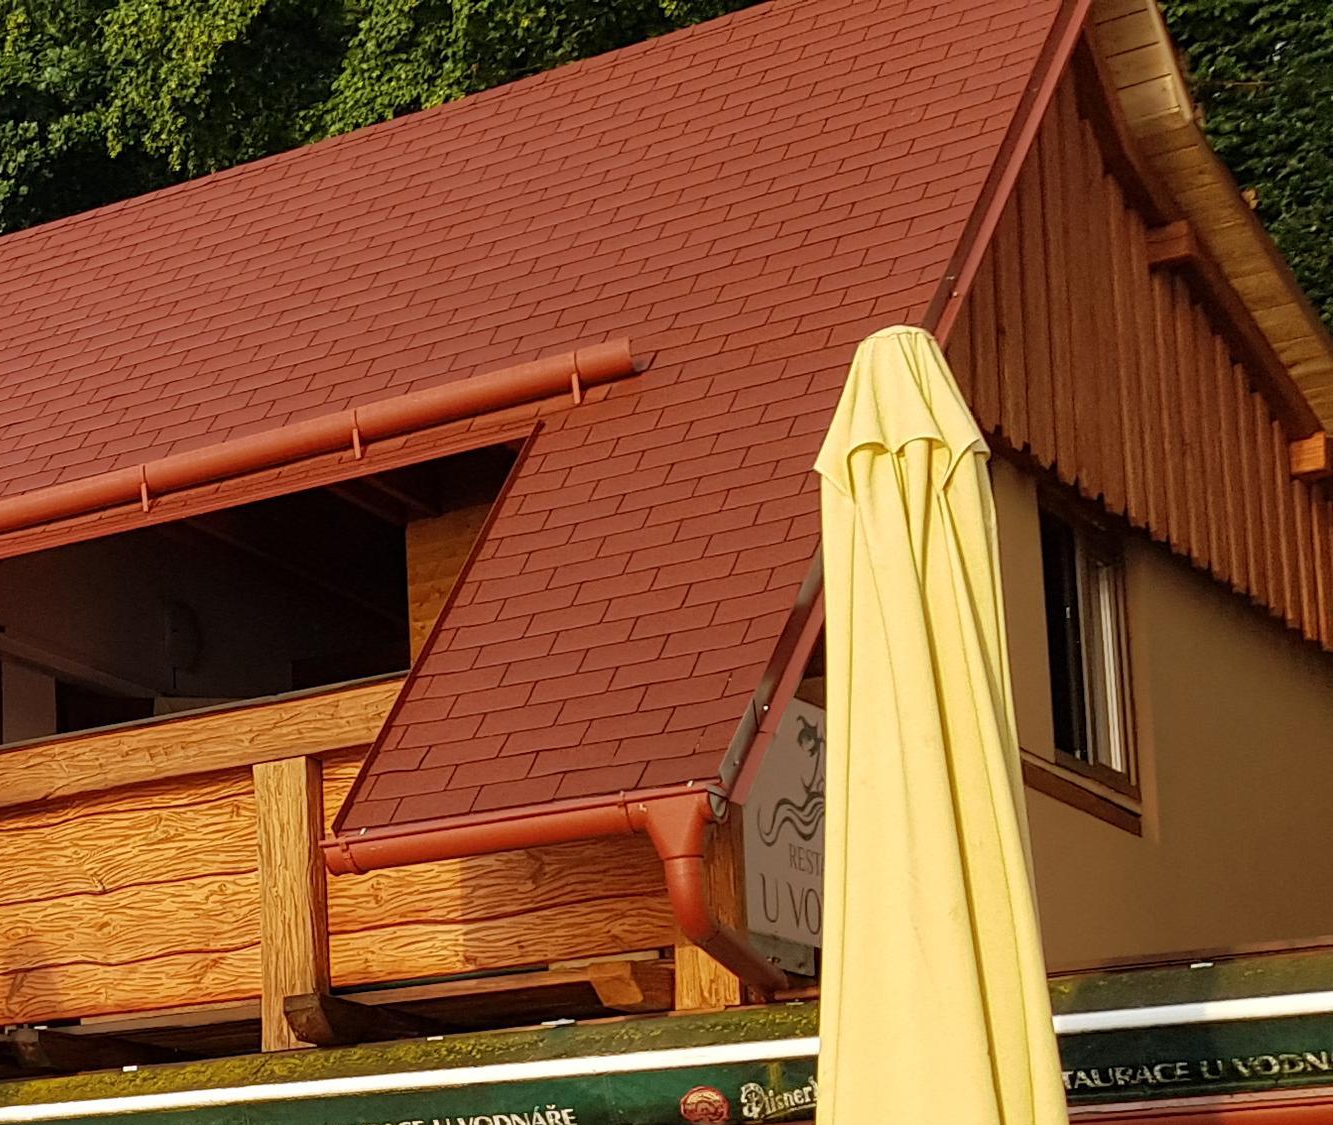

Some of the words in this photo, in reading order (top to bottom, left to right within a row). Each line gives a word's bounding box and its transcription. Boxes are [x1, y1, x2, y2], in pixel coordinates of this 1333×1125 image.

[788, 843, 822, 877] REST
[760, 873, 780, 924] U
[786, 881, 822, 936] VO
[1063, 1061, 1191, 1090] TAURACE
[1200, 1059, 1222, 1080] U
[1232, 1051, 1333, 1078] VODN
